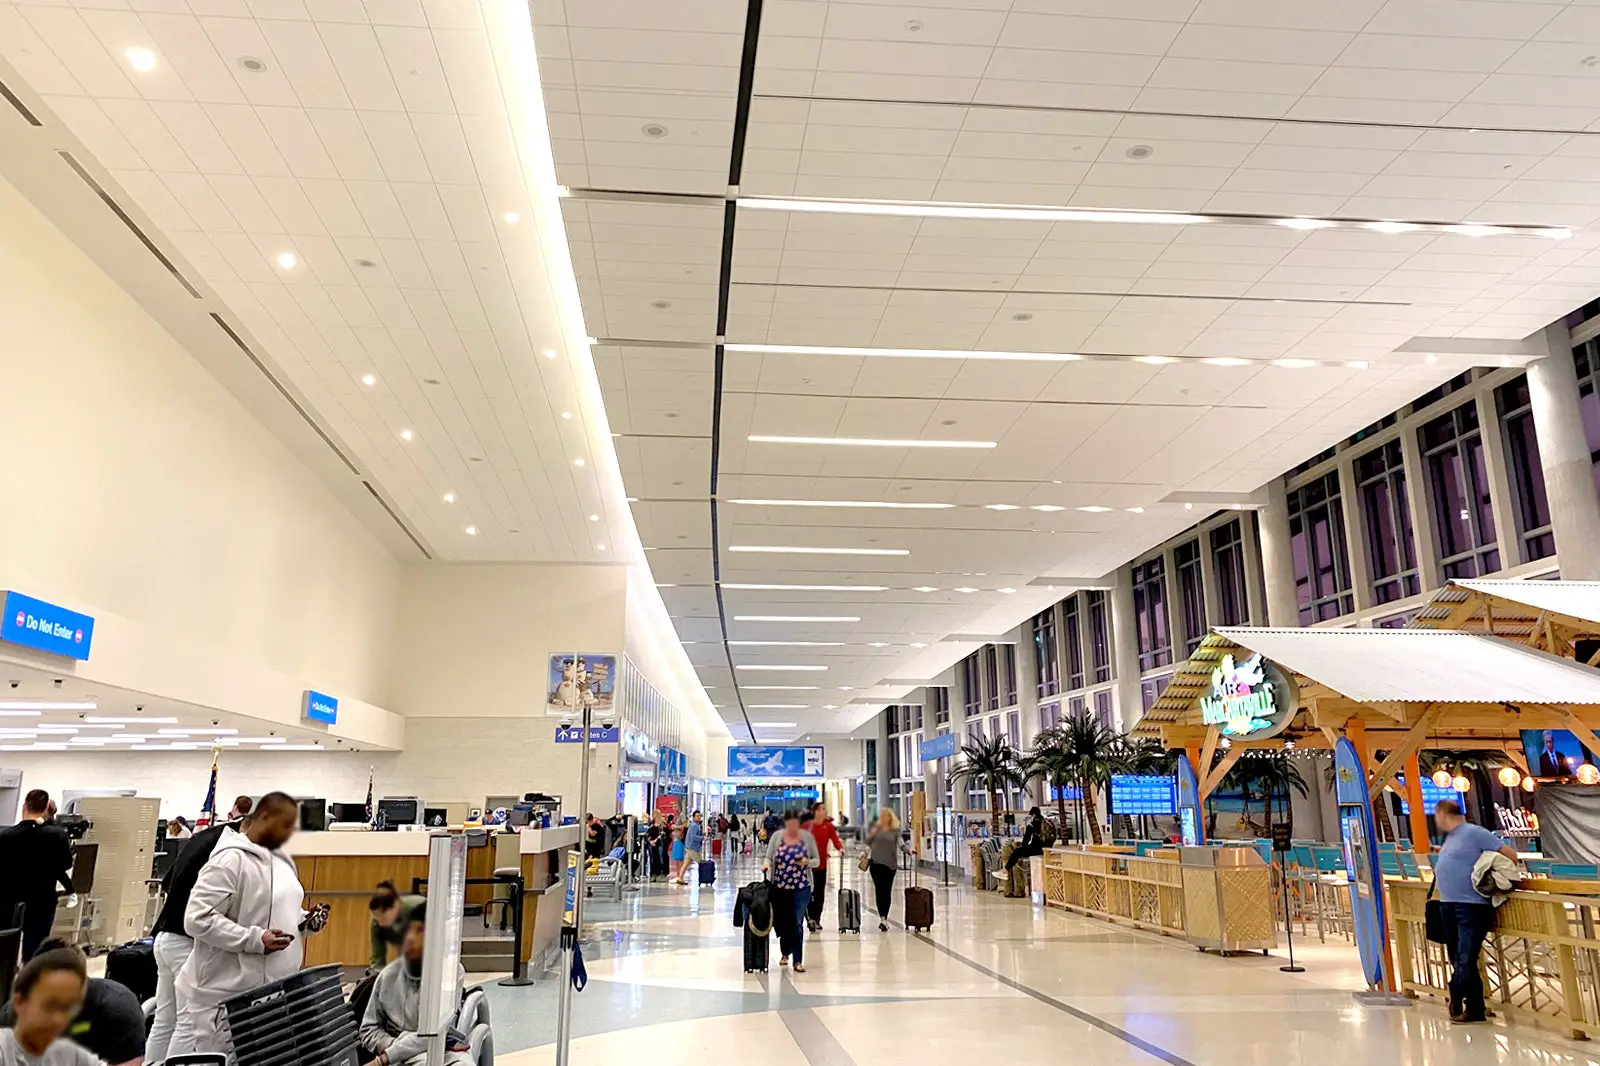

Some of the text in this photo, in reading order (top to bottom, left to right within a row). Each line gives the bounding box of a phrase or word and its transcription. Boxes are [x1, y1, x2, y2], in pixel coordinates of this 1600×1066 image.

[26, 614, 74, 640] Do Not Enter
[580, 731, 608, 739] Gtes C
